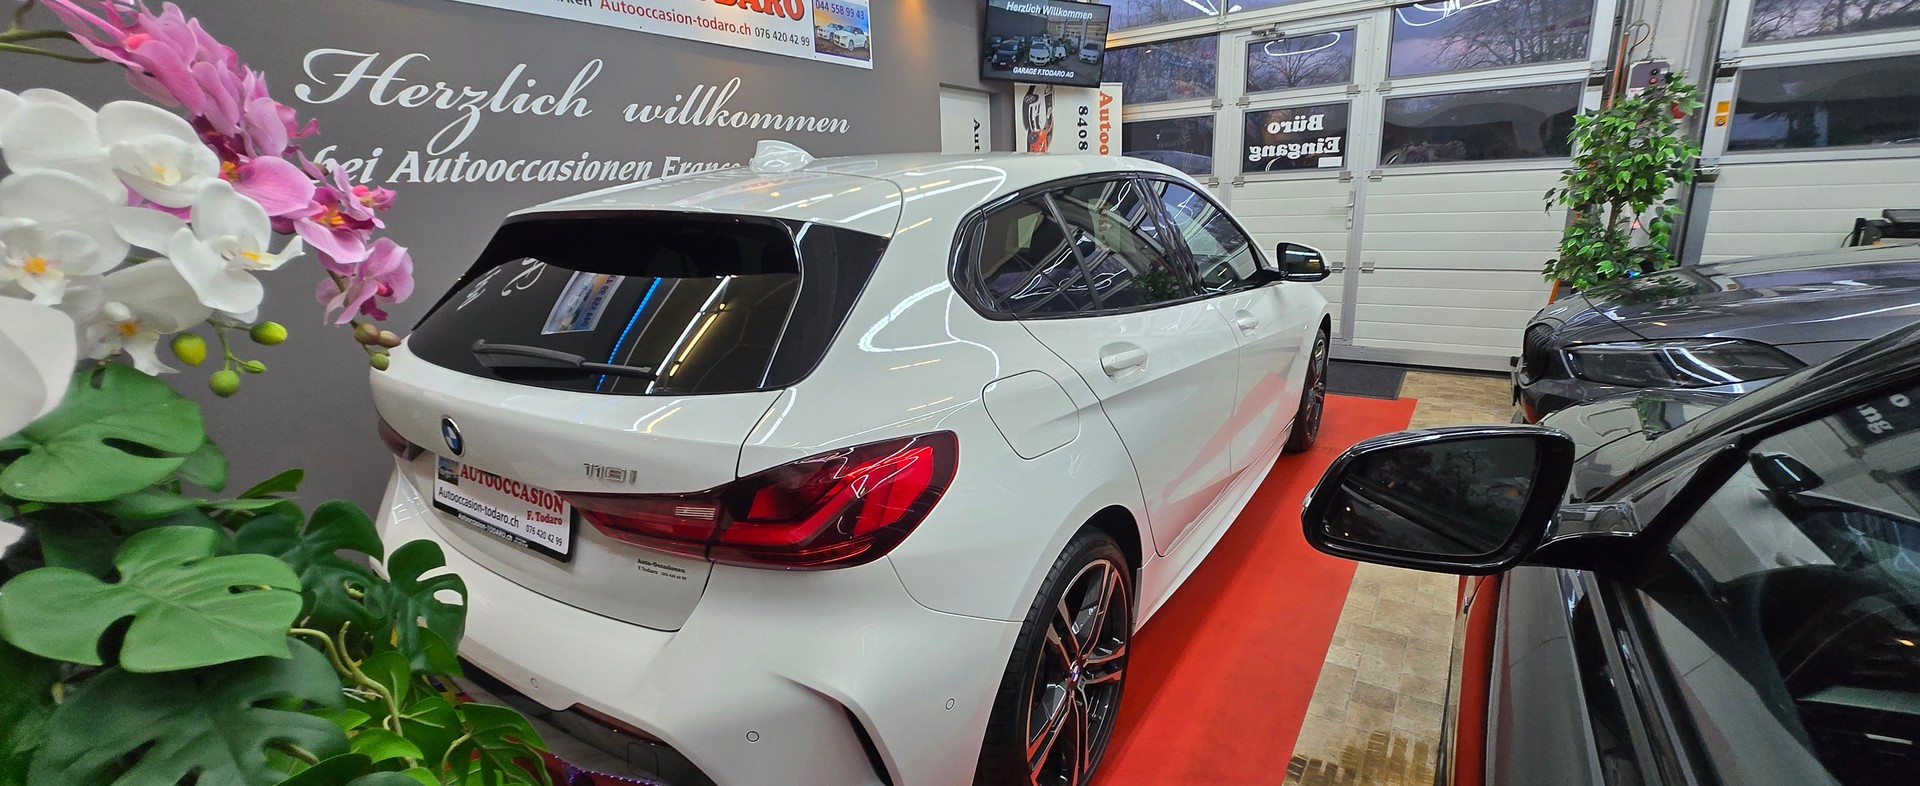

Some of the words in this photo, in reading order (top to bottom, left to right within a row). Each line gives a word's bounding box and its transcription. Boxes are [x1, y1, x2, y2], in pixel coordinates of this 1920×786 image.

[600, 0, 752, 36] Autooccasion-todaro.ch
[754, 26, 771, 40] 076
[772, 30, 788, 43] 420
[789, 33, 800, 45] 42
[800, 35, 811, 47] 99
[815, 0, 829, 12] 044
[831, 3, 845, 16] 558
[845, 5, 855, 18] 99
[855, 8, 865, 20] 43
[1006, 1, 1041, 15] Herzlich
[1042, 5, 1093, 20] Willkommen
[1013, 66, 1038, 76] GARAGE
[294, 48, 603, 155] Herzlich
[623, 77, 851, 136] willkommen
[1077, 105, 1089, 151] 8408
[385, 150, 653, 184] Autooccasionen
[460, 464, 565, 515] AUTOOCCASION
[438, 486, 520, 529] Autooccasion-todaro.ch
[535, 511, 563, 526] Todaro
[525, 524, 536, 536] 076
[536, 528, 547, 540] 420
[547, 533, 555, 544] 42
[555, 537, 563, 547] 99
